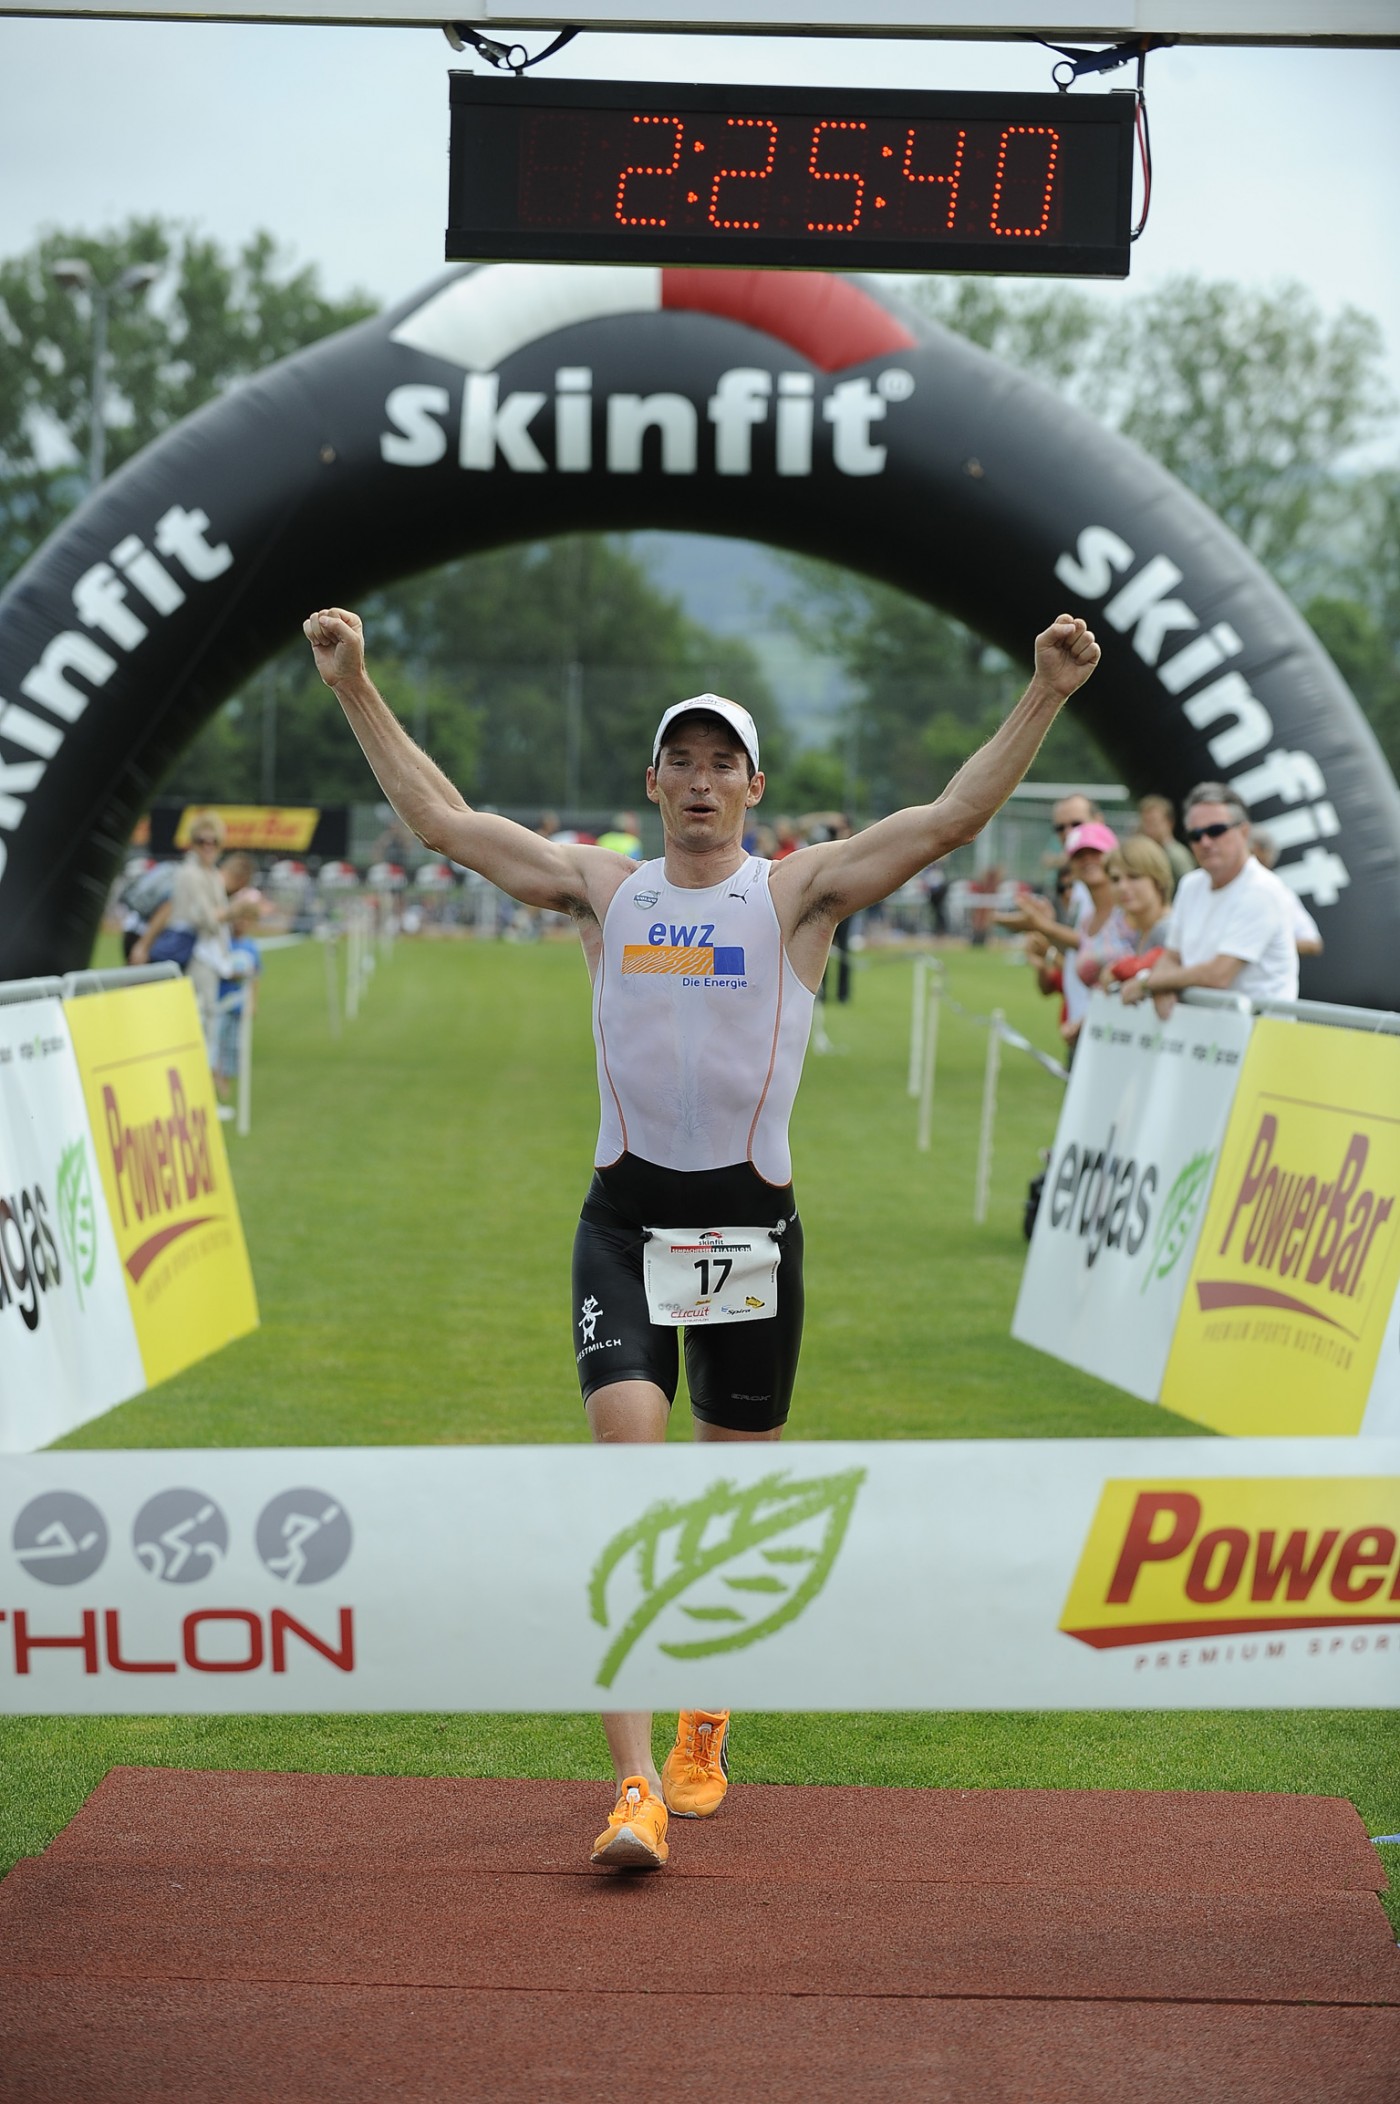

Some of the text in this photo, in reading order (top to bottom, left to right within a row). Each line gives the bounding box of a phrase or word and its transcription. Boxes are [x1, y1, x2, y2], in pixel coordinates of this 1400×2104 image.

[615, 116, 1060, 237] 2:25:40
[1054, 525, 1350, 906] skinfit
[648, 922, 715, 947] ewz
[682, 977, 748, 989] Die Energie
[102, 1067, 216, 1230] PowerBar
[1219, 1113, 1395, 1298] PowerBar
[694, 1259, 732, 1296] 17
[0, 1606, 356, 1674] HLON
[1134, 1632, 1400, 1672] PREMIUM SPOR
